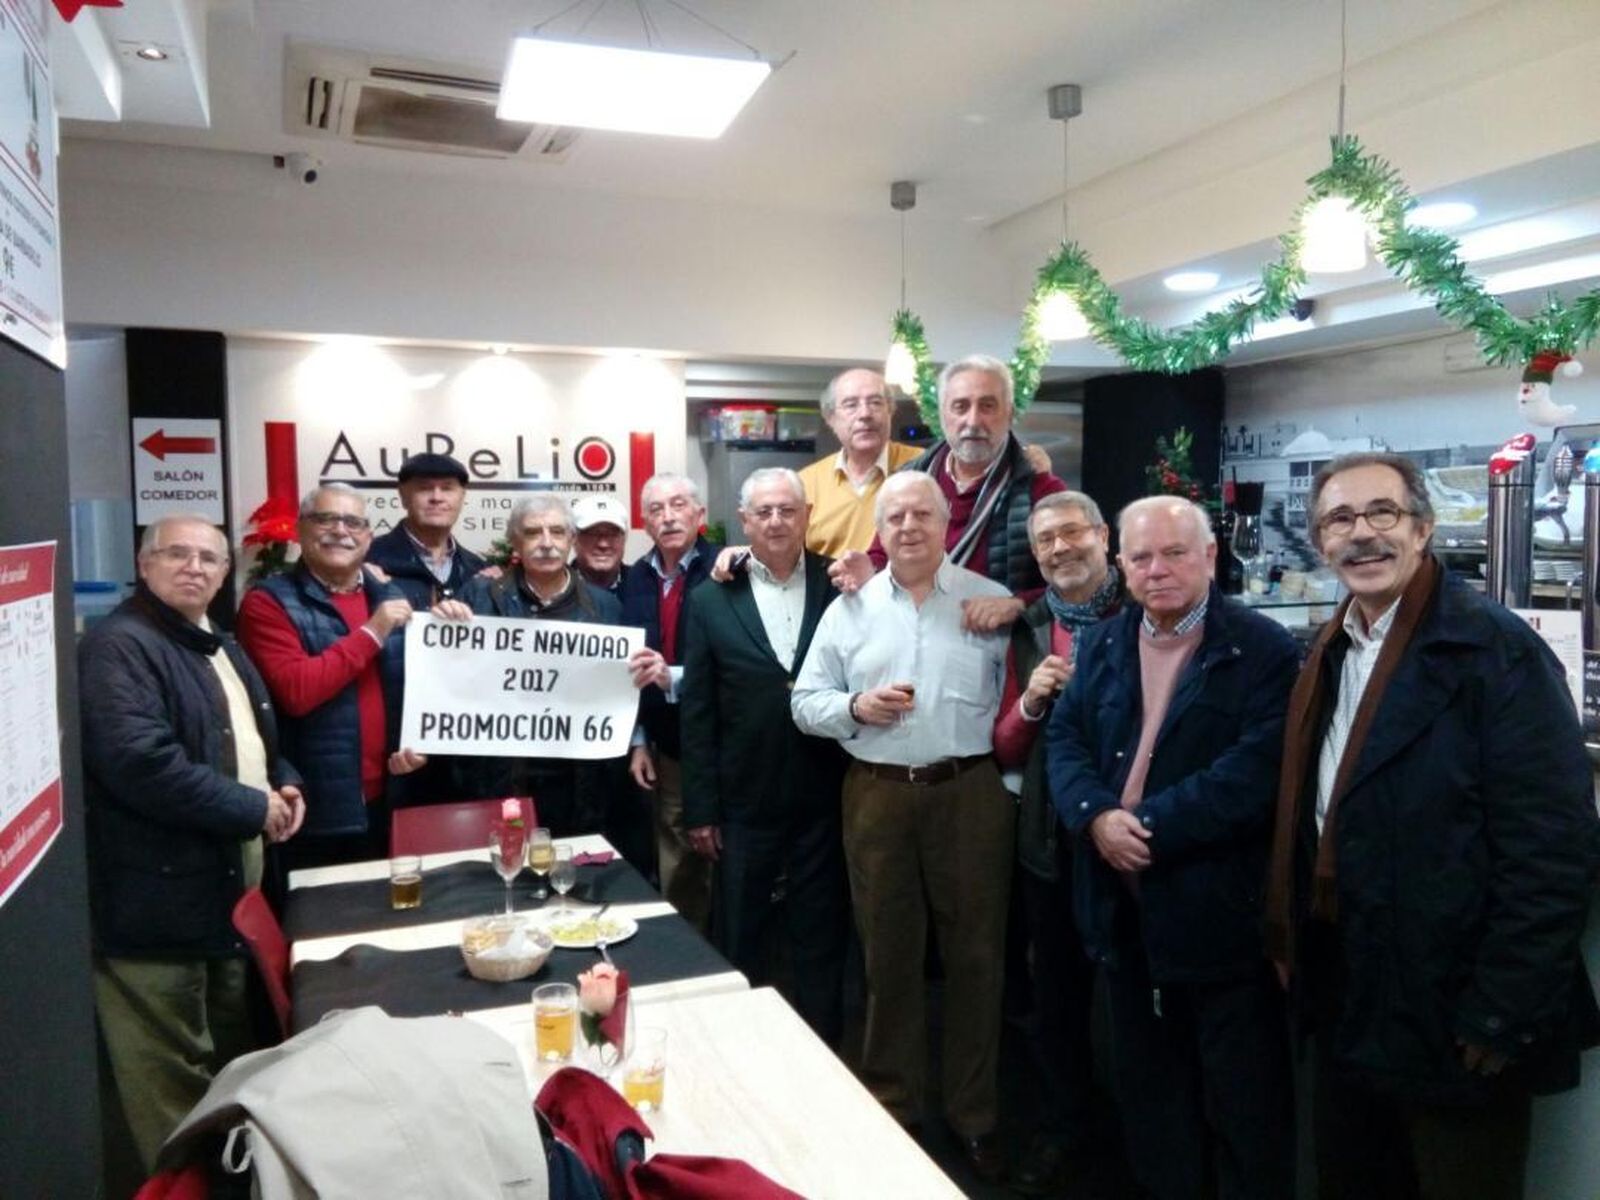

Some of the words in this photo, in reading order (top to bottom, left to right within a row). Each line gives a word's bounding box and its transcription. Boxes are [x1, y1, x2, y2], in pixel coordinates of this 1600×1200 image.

[153, 469, 204, 481] SALÓN
[140, 489, 219, 500] COMEDOR
[423, 623, 485, 649] COPA
[495, 627, 525, 651] DE
[534, 629, 629, 659] NAVIDAD
[503, 668, 560, 692] 2017
[420, 708, 571, 741] PROMOCIÓN
[583, 715, 613, 742] 66
